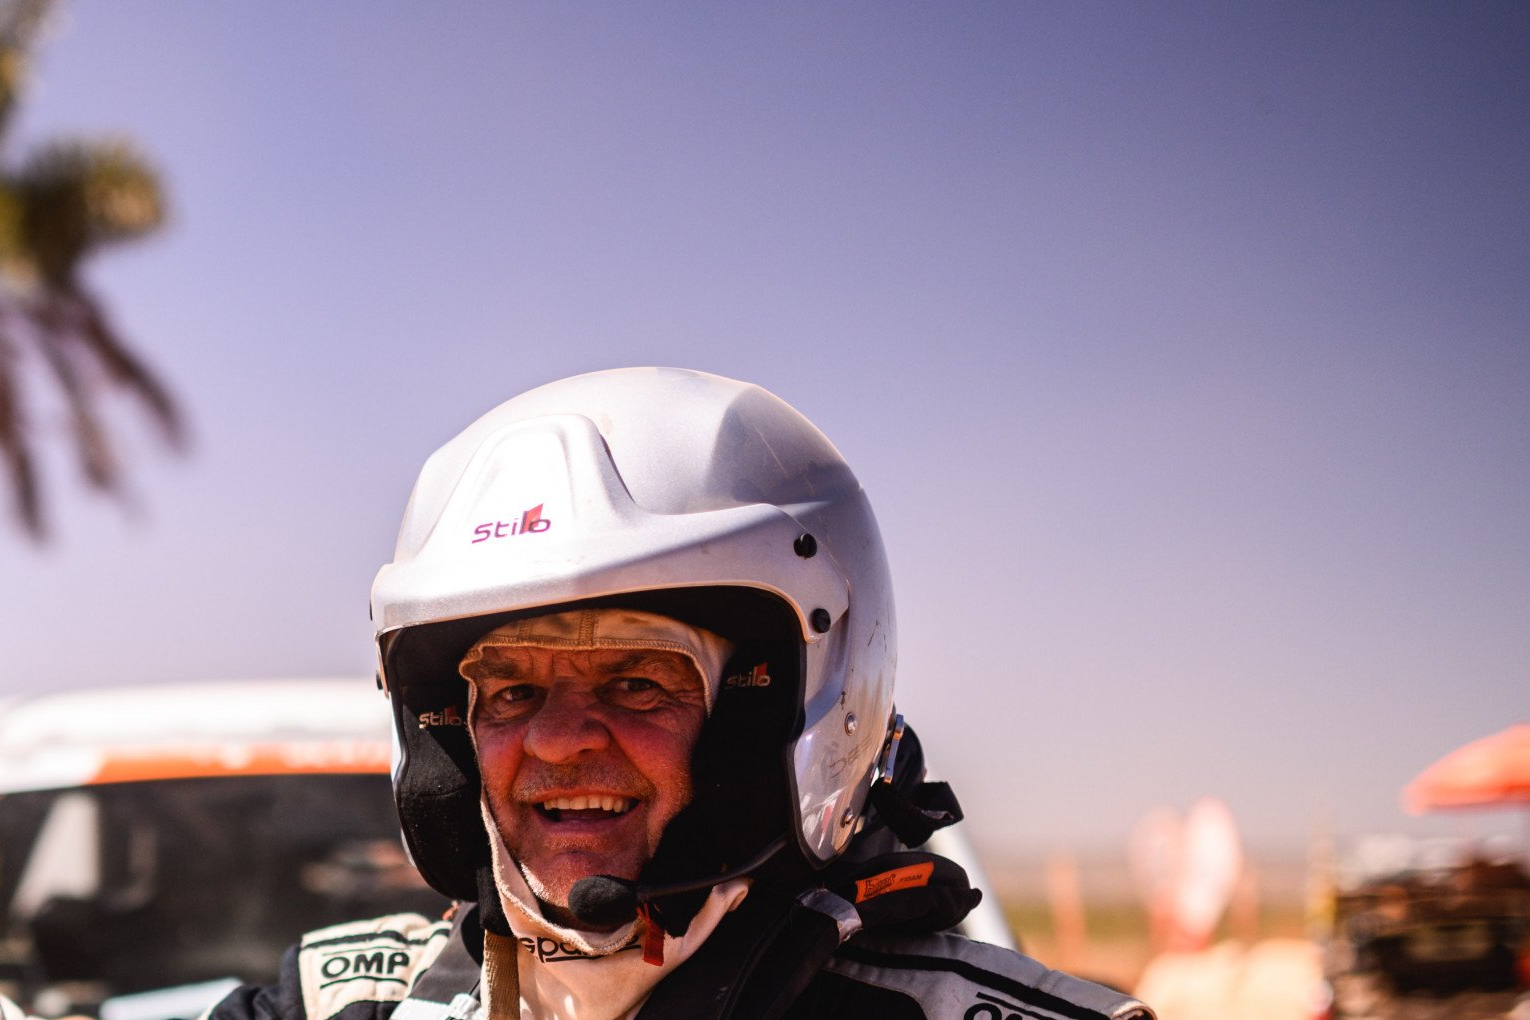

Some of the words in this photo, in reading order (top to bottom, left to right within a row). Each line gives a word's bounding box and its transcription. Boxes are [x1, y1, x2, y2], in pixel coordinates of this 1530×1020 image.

[472, 503, 552, 545] Stilo
[419, 706, 463, 729] Stilo
[320, 951, 410, 979] OMP
